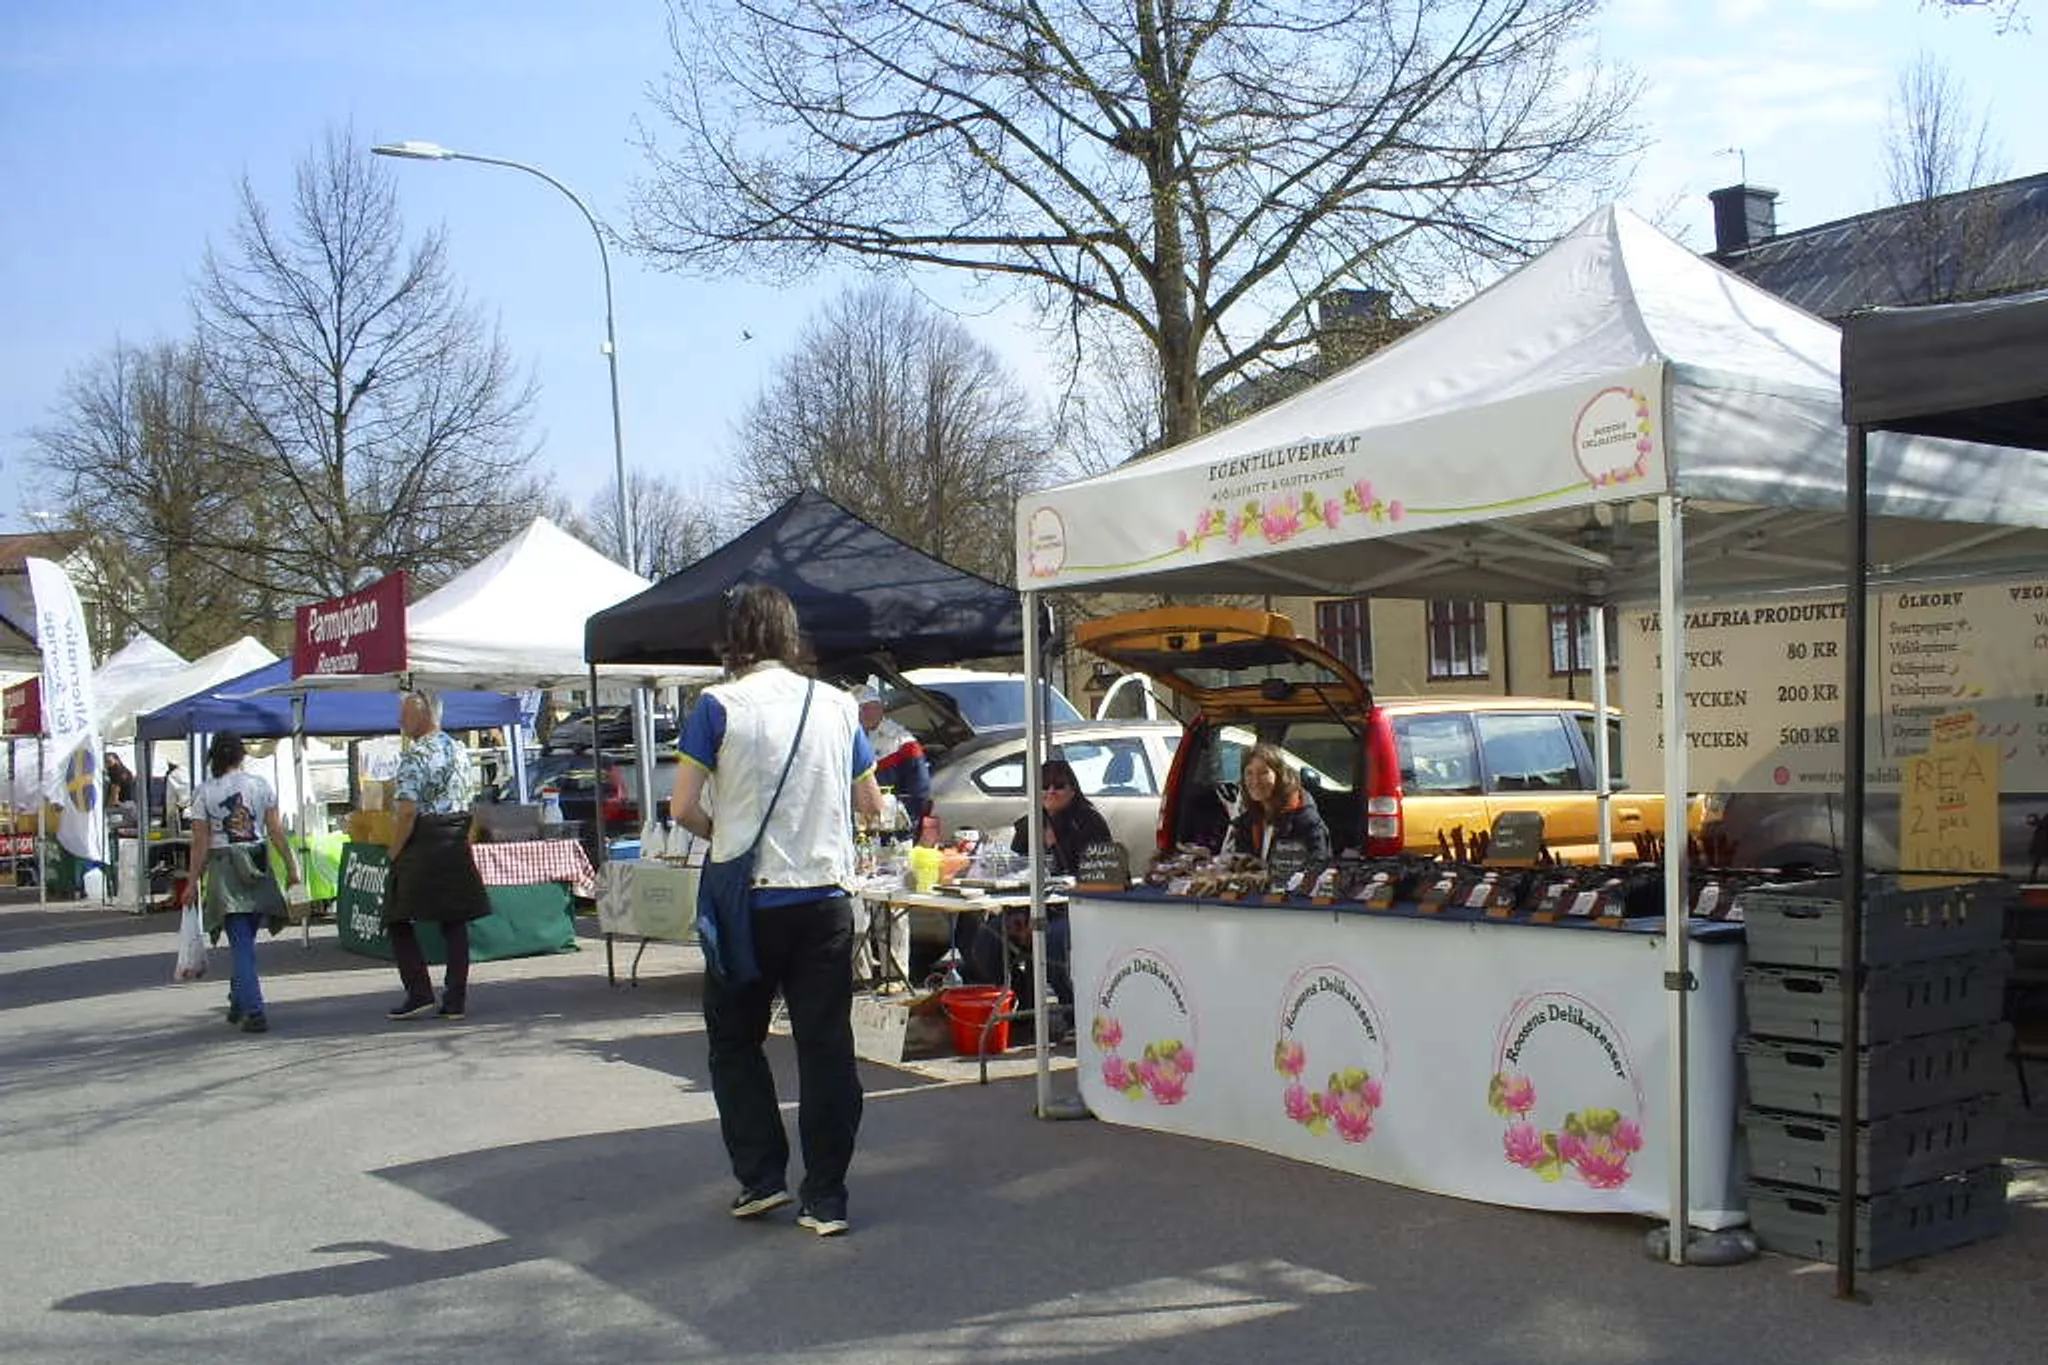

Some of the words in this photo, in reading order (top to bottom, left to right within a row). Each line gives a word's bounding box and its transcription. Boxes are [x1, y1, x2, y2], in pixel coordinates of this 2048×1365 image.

[1208, 436, 1361, 481] EGENTILLVERKAT
[1899, 592, 1963, 609] ÖLKORV
[308, 598, 378, 647] Parmigiano
[1787, 643, 1807, 660] 80
[1812, 642, 1838, 658] KR
[1778, 685, 1808, 703] 200
[1812, 684, 1839, 701] KR
[1780, 728, 1809, 746] 500
[1813, 727, 1840, 744] KR
[1914, 753, 1986, 792] REA
[1909, 805, 1929, 836] 2
[1547, 1003, 1626, 1080] Delikatesser
